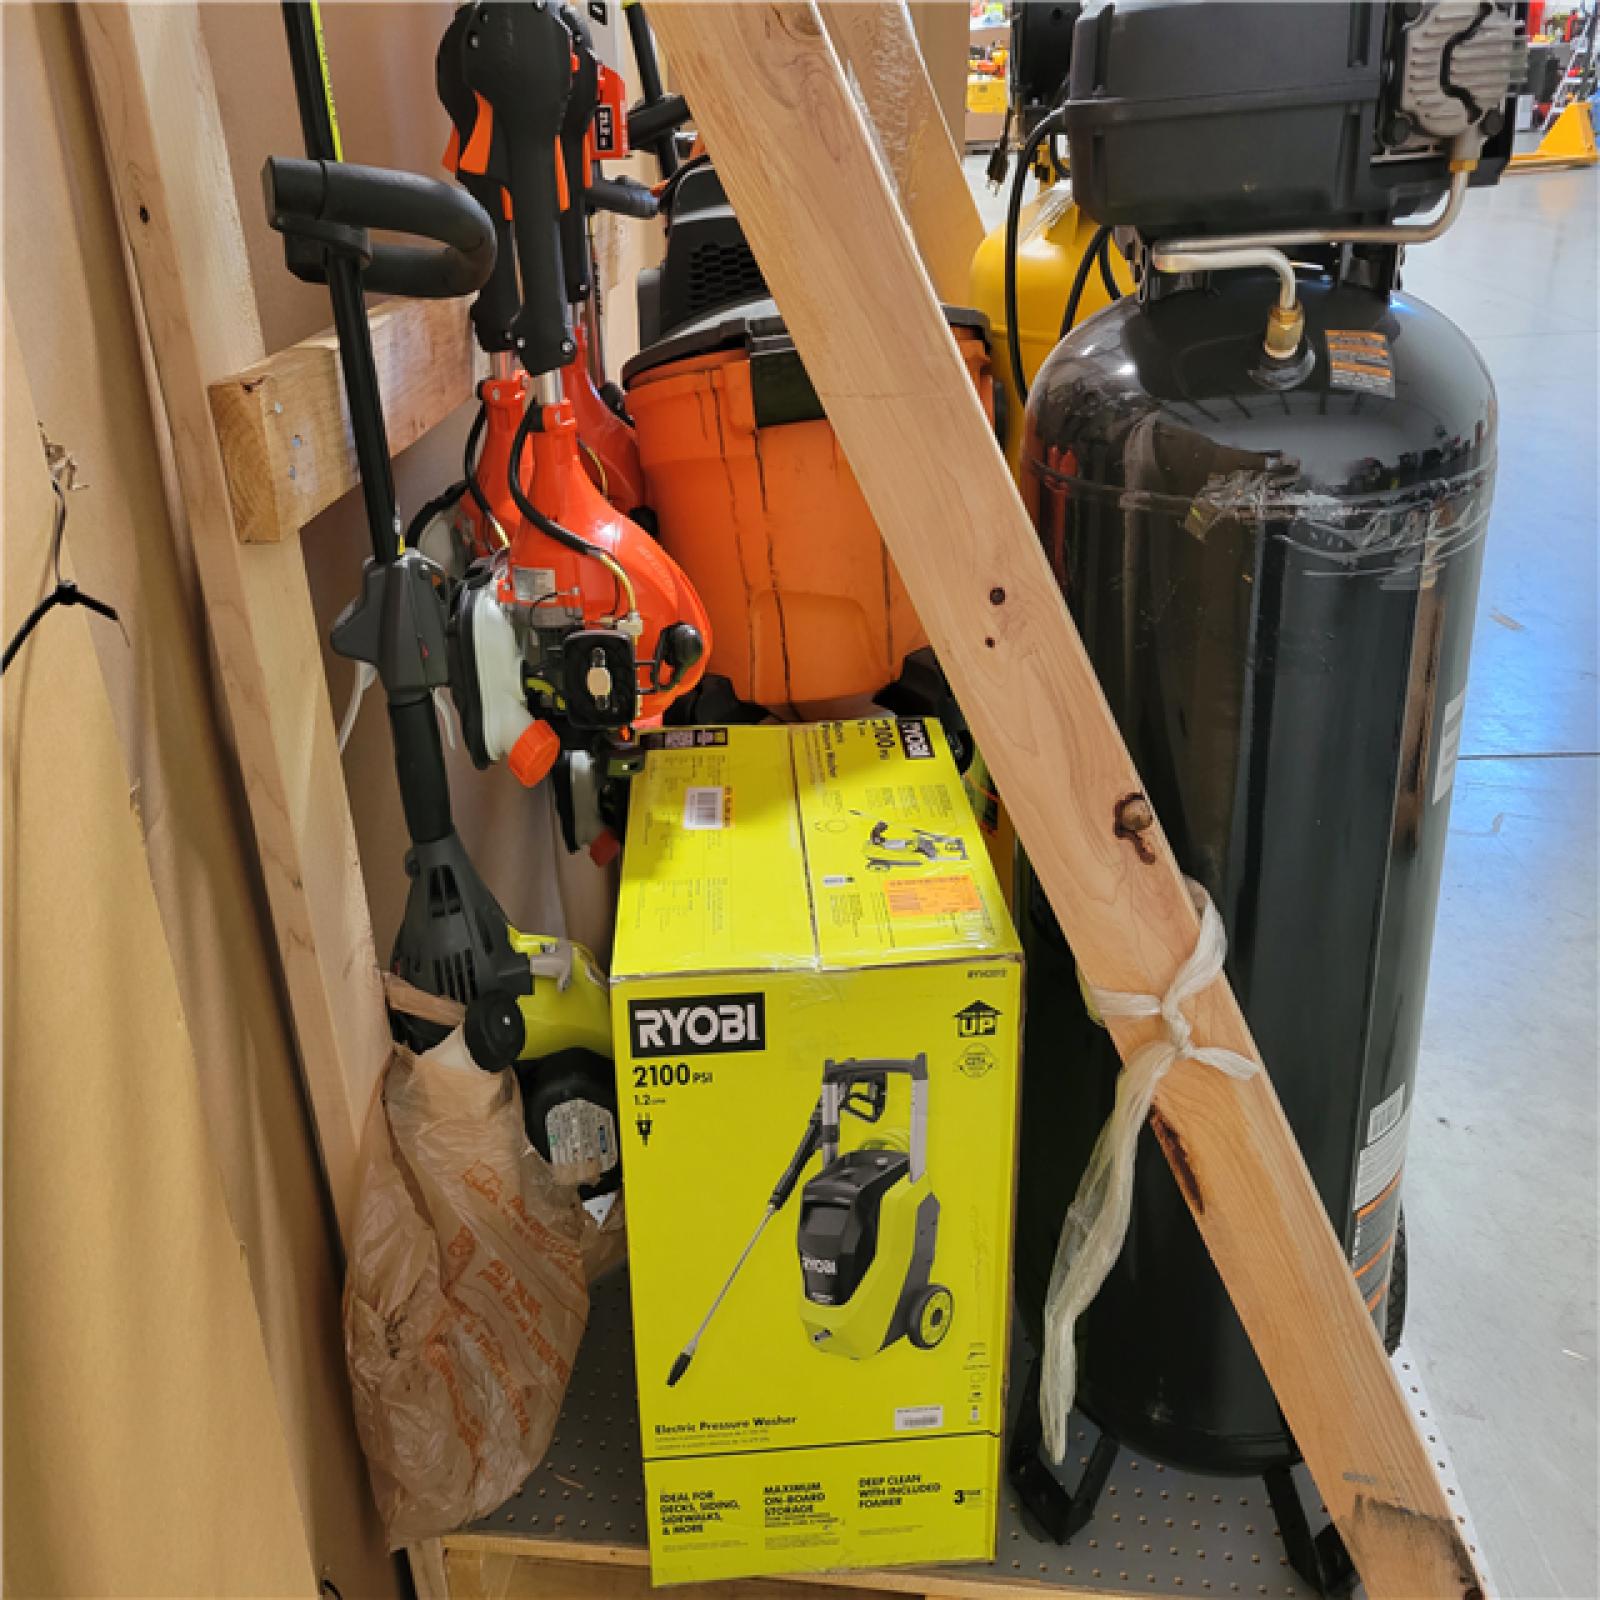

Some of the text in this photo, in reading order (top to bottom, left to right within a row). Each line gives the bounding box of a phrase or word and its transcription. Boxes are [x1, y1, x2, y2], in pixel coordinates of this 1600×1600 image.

[634, 1003, 760, 1049] RYOBI
[961, 1012, 995, 1034] UP
[632, 1062, 713, 1088] 2100 PSI
[654, 1414, 797, 1436] Electric Pressure Washer
[764, 1481, 821, 1494] MAXIMUM
[858, 1474, 922, 1488] DEEP CLEAN
[659, 1490, 715, 1503] IDEAL FOR
[858, 1482, 941, 1498] WITH INCLUDED
[953, 1489, 966, 1505] 3
[764, 1492, 826, 1505] ON-BOARD
[858, 1496, 902, 1509] FOAMER
[764, 1503, 814, 1516] STORAGE
[672, 1524, 704, 1534] MORE
